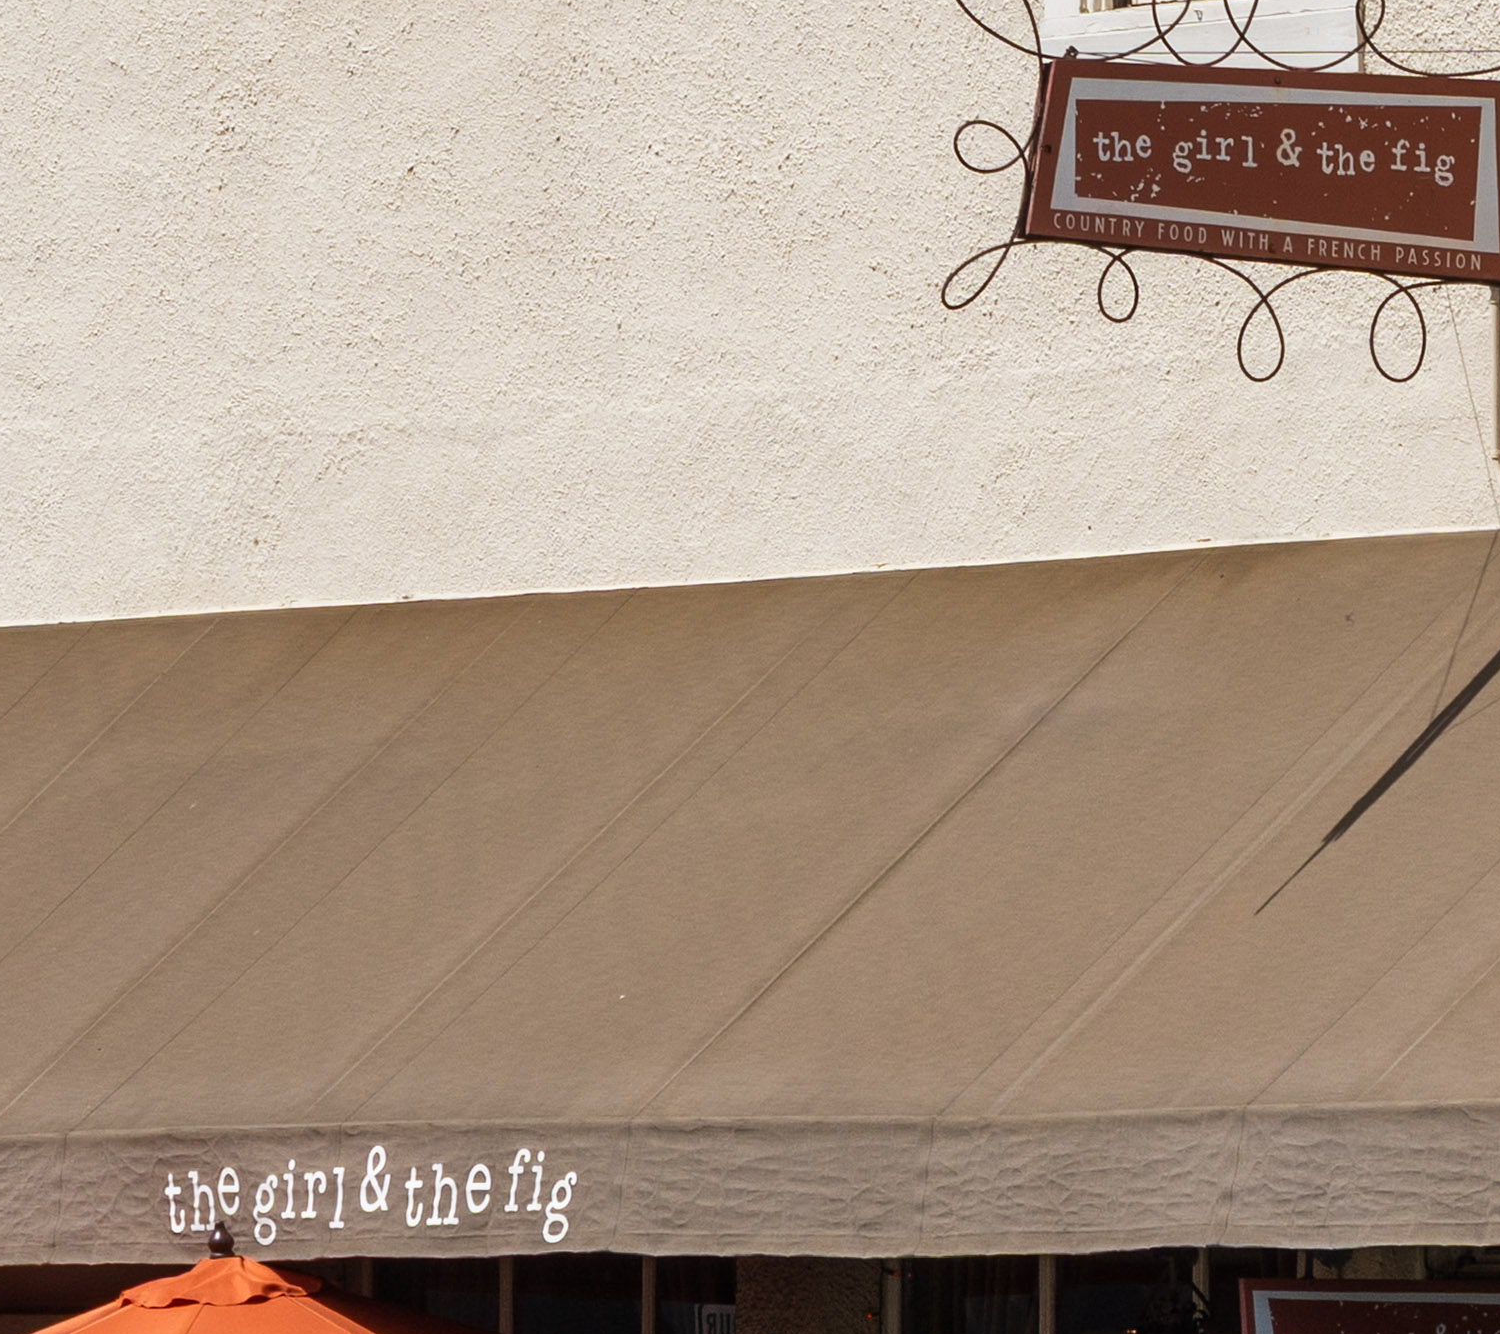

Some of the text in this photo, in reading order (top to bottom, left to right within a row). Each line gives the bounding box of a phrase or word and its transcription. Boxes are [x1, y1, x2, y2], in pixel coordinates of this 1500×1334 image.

[1094, 128, 1455, 187] the girl & the fig
[1054, 213, 1482, 271] COUNTRY FOOD WITH A FRENCH PASSION
[164, 1145, 578, 1245] the girl & the fig
